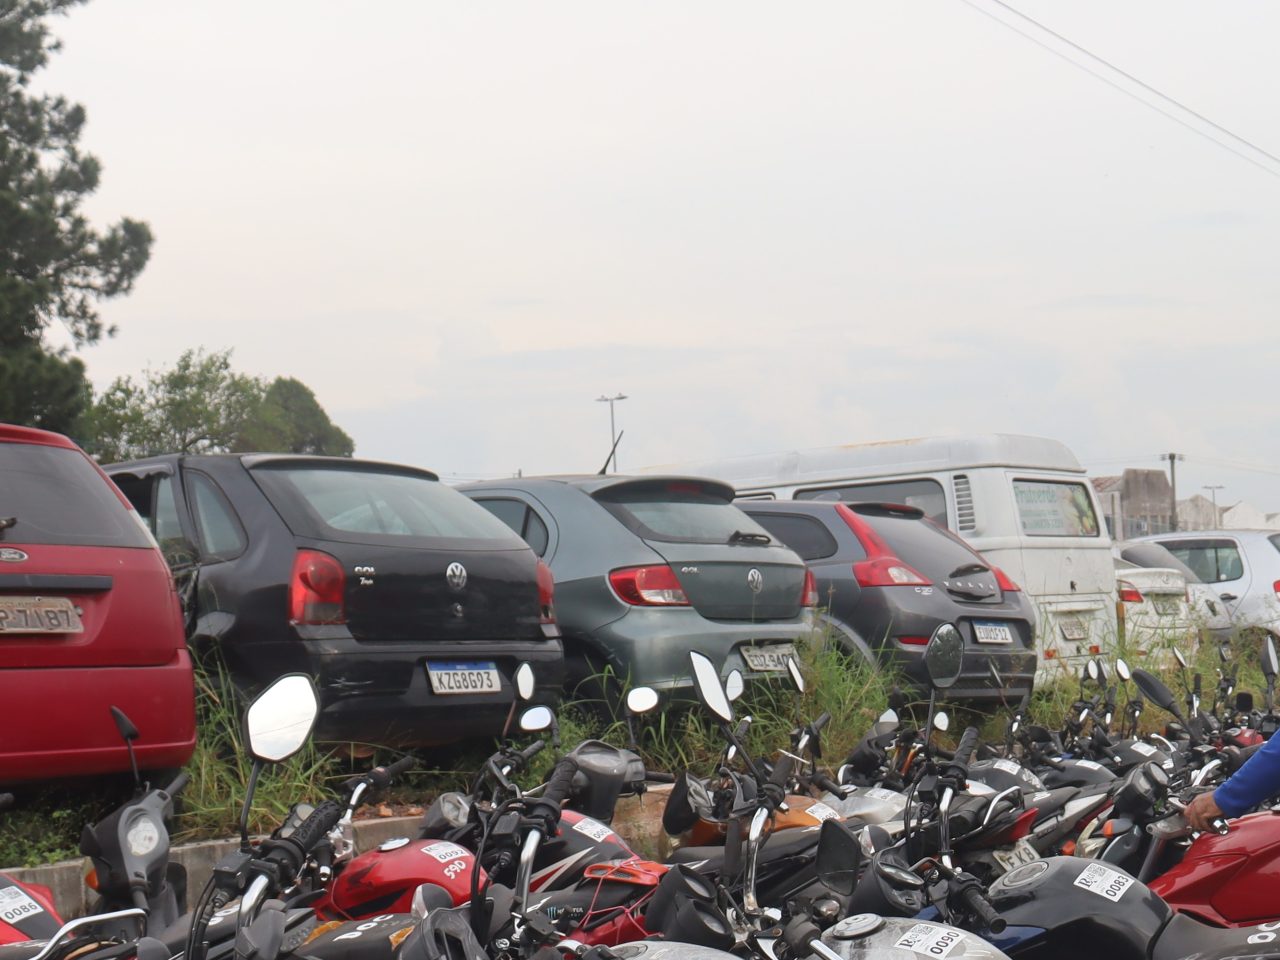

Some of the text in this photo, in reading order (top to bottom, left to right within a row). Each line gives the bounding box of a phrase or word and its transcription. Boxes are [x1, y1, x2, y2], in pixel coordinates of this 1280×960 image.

[436, 671, 493, 690] KZG8G93
[1104, 874, 1130, 898] 0083
[4, 902, 38, 920] 0086
[929, 930, 961, 955] 0090
